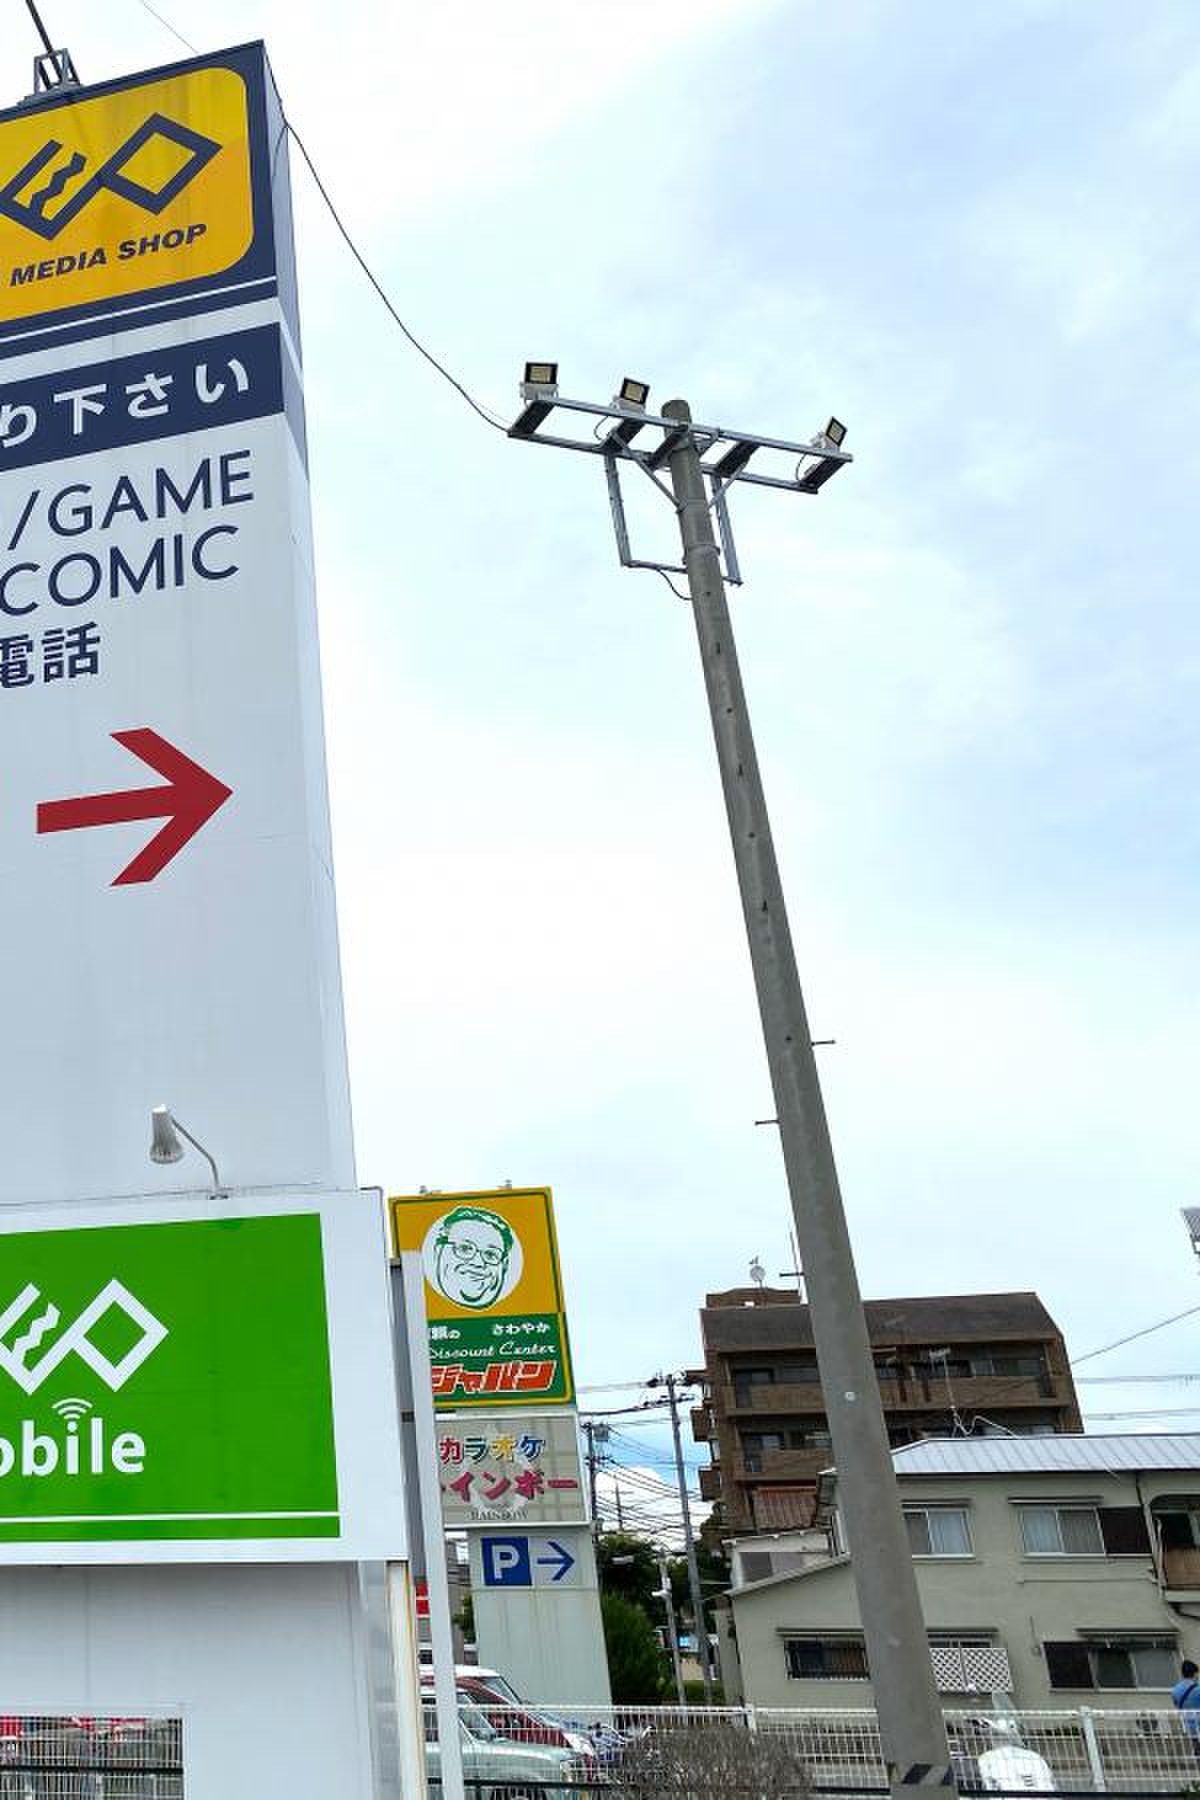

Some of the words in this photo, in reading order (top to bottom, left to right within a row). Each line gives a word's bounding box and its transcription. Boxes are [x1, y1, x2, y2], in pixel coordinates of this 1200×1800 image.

[10, 248, 108, 287] MEDIA
[116, 223, 207, 262] SHOP
[499, 1340, 557, 1356] Center
[438, 1434, 546, 1465] カラオケ
[440, 1470, 579, 1502] インボー
[491, 1544, 520, 1581] P
